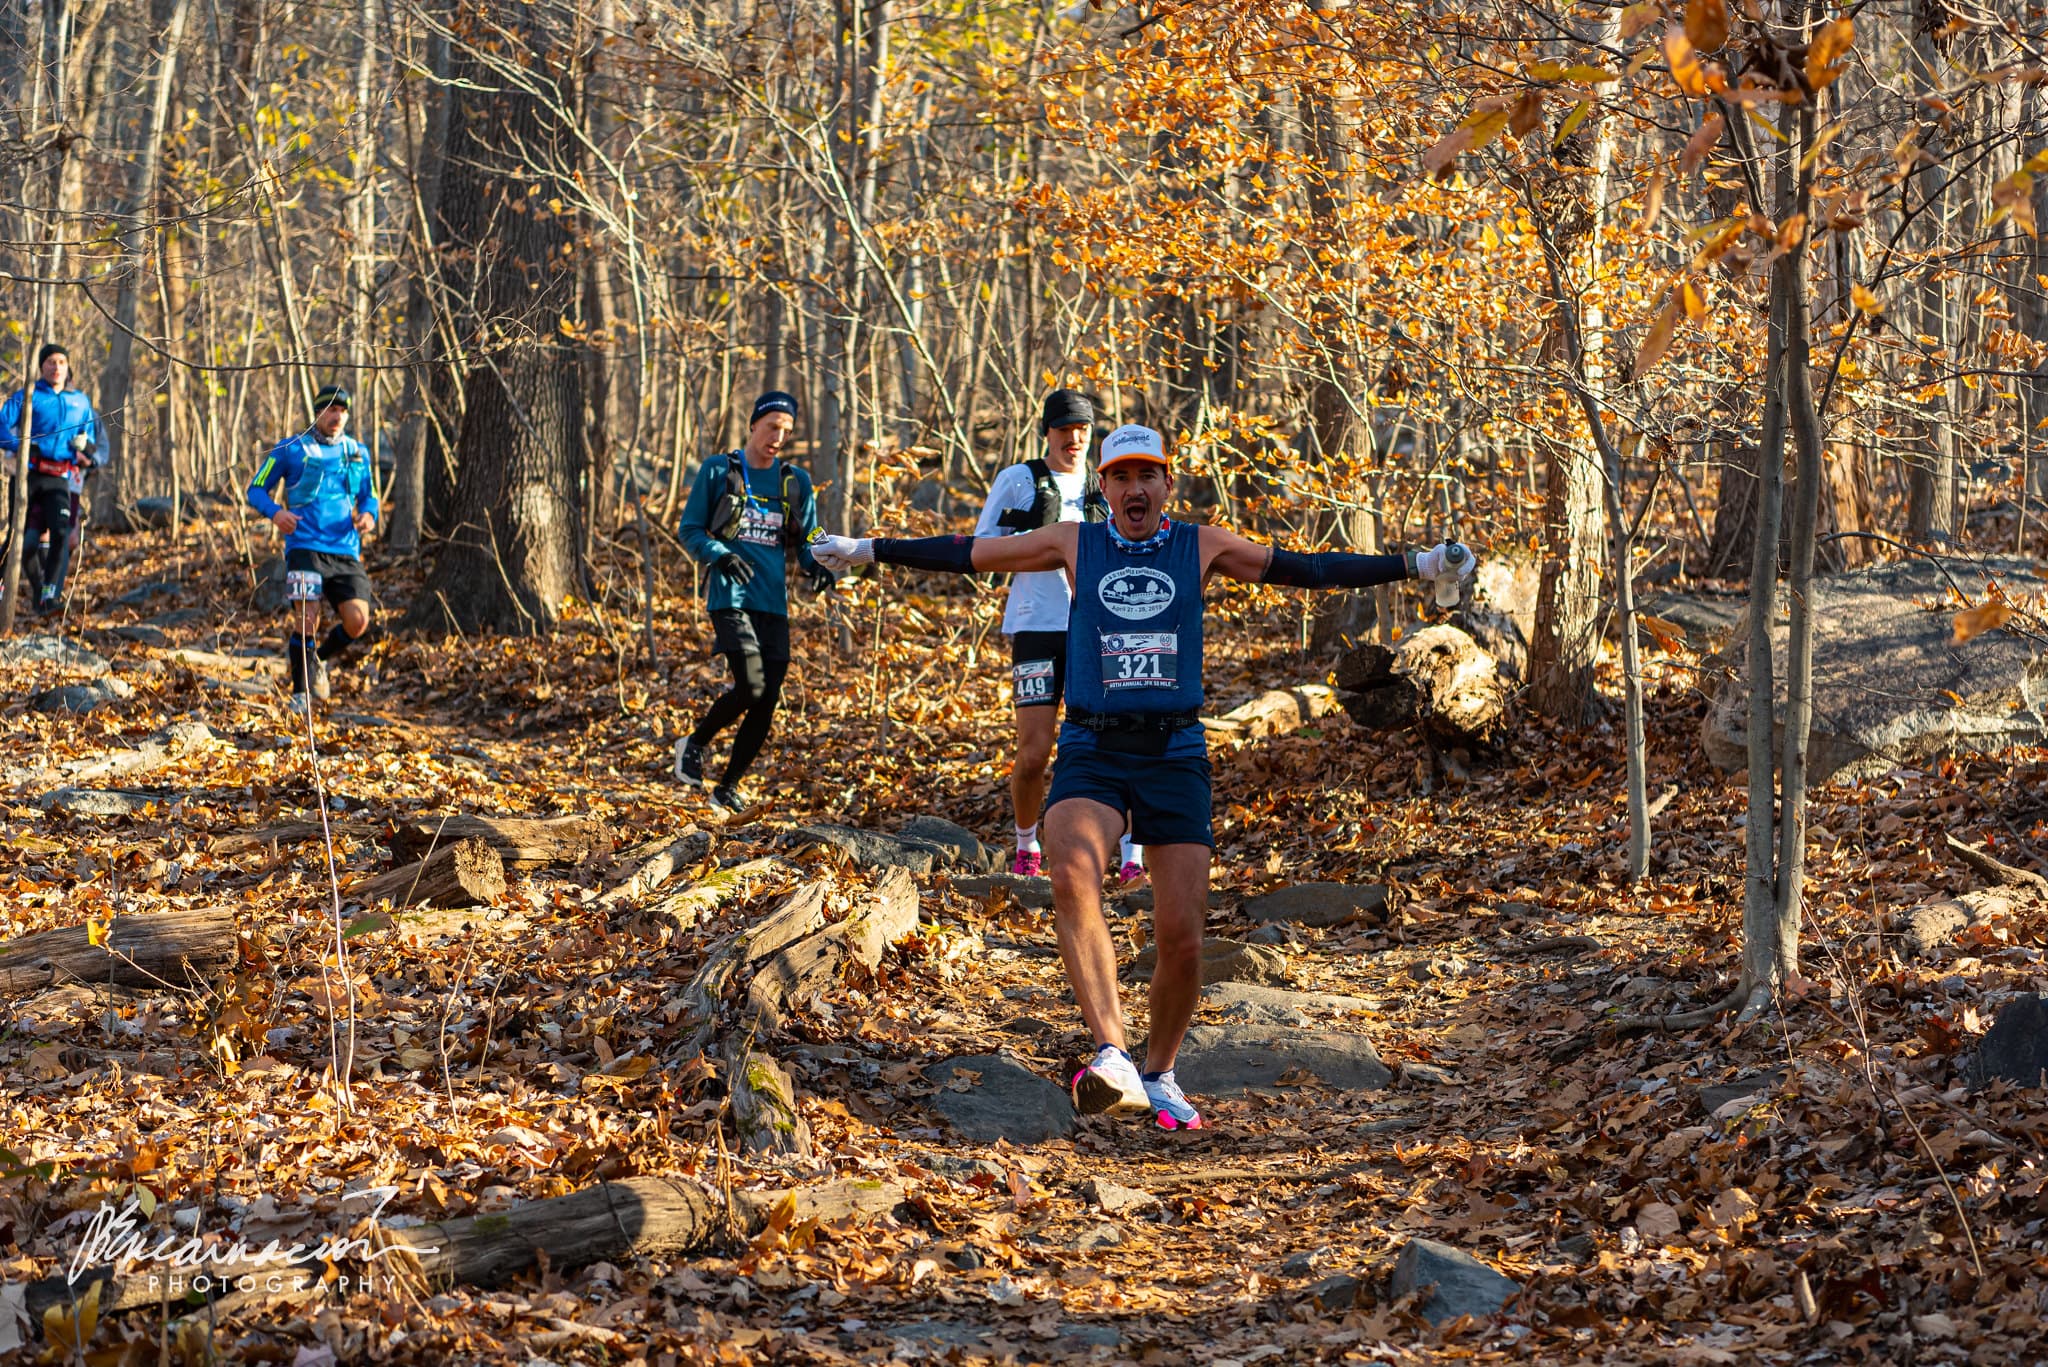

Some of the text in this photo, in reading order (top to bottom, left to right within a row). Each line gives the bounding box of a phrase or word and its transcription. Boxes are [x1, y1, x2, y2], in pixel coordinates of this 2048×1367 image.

[292, 581, 316, 596] 102
[1111, 604, 1126, 613] April
[1117, 654, 1162, 679] 321
[1017, 677, 1046, 697] 449
